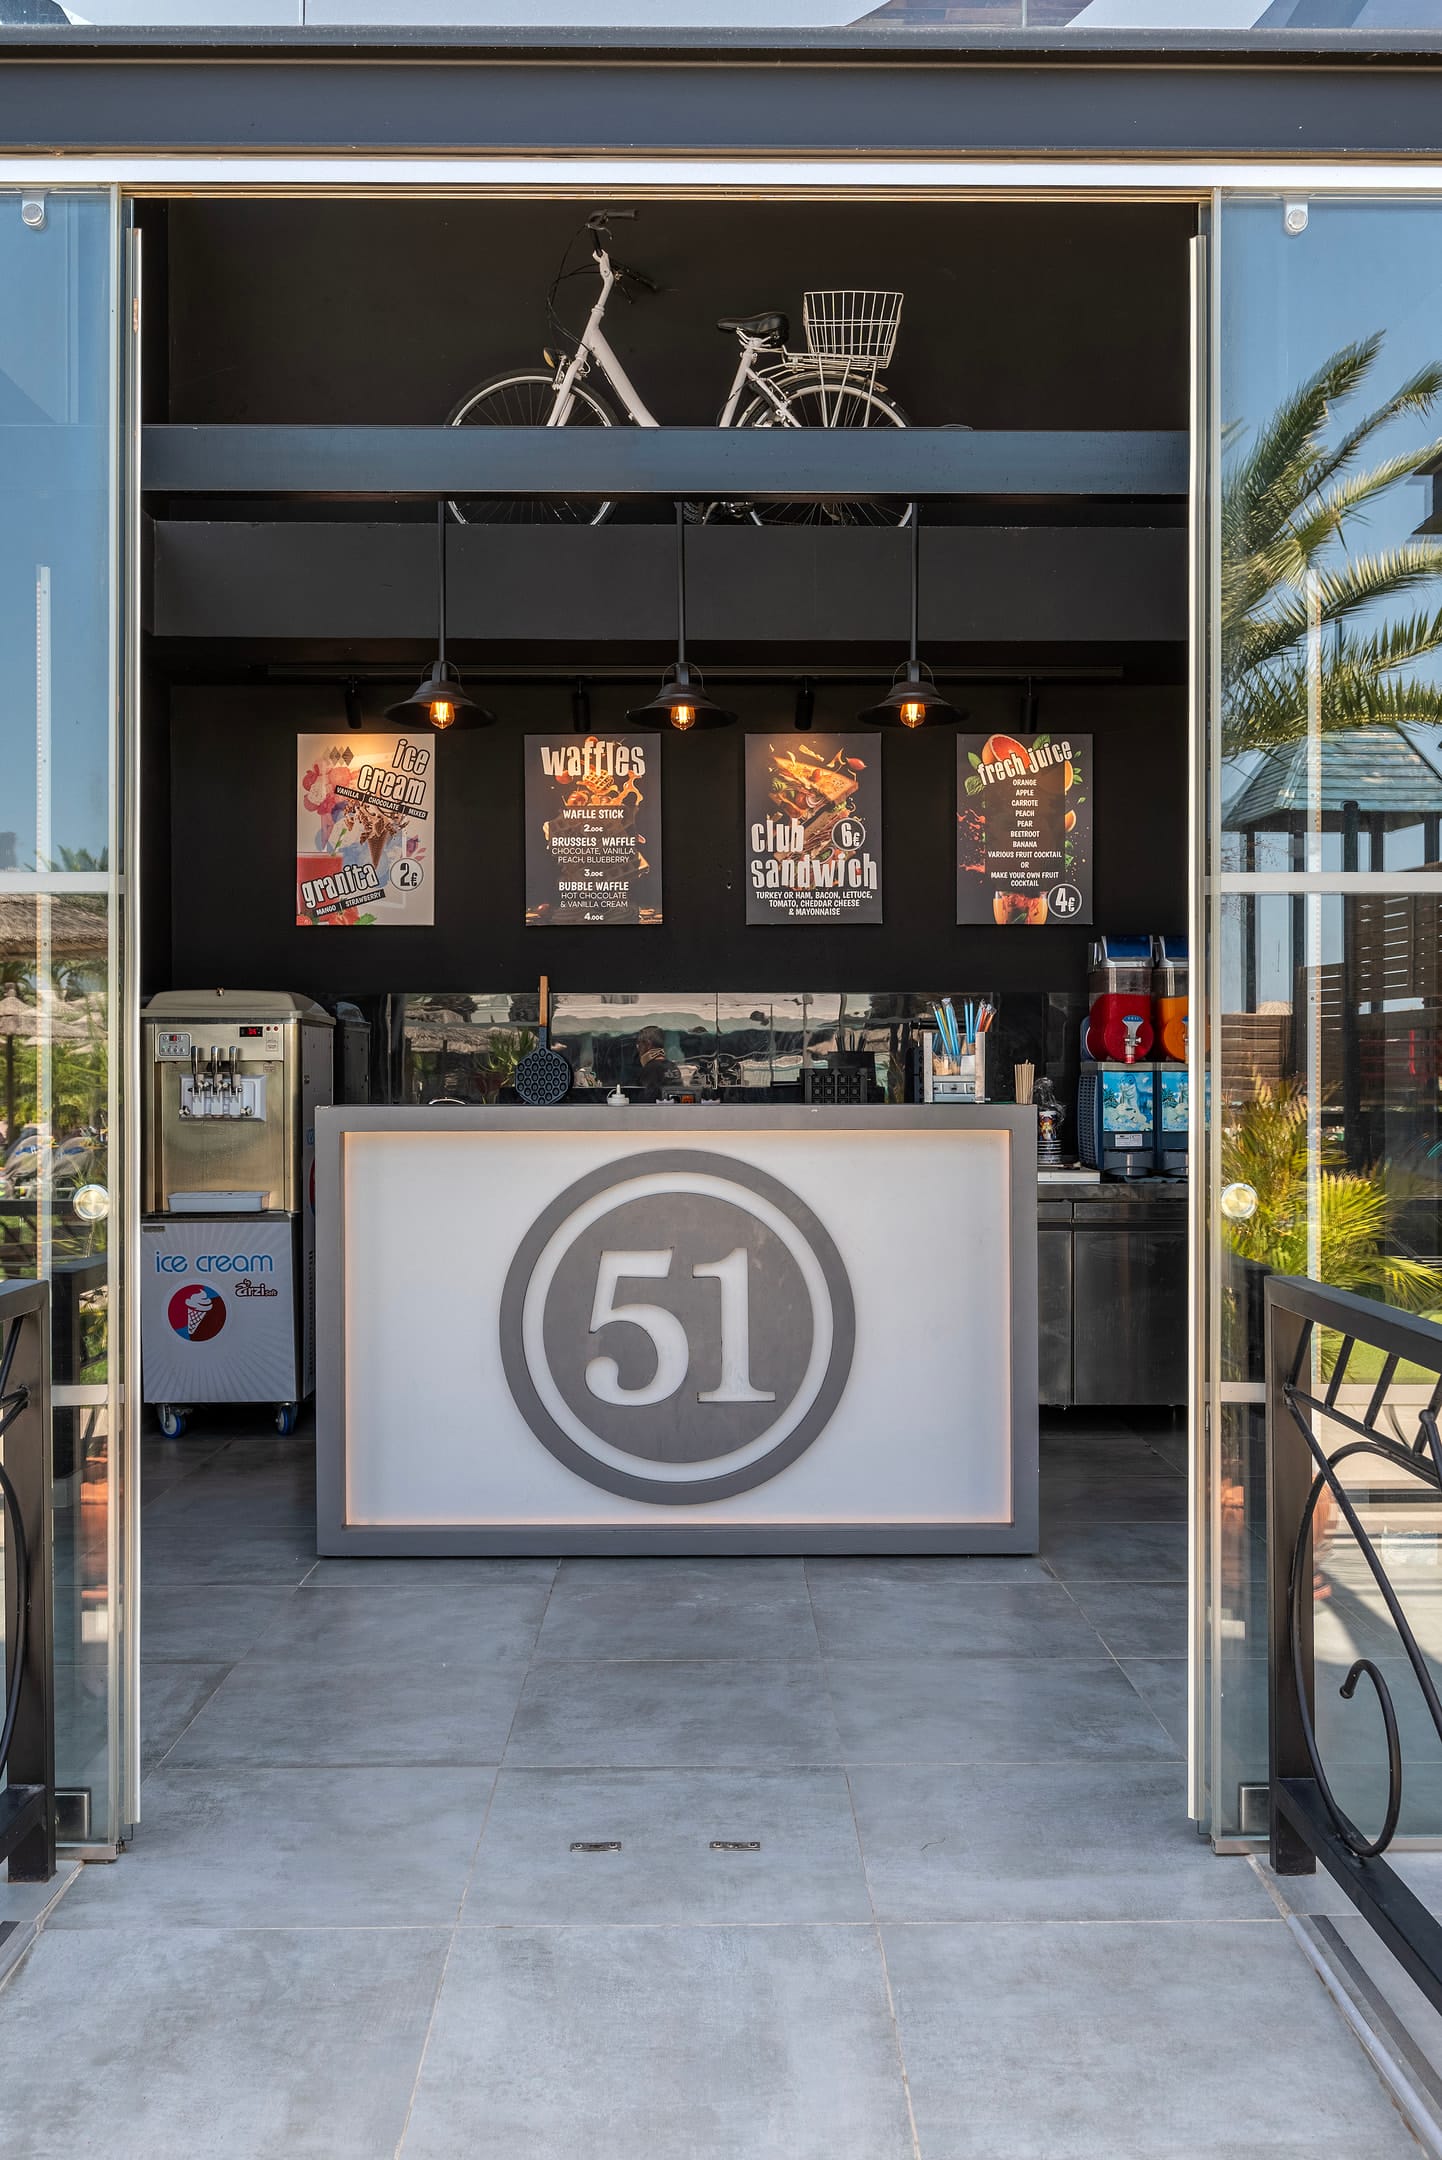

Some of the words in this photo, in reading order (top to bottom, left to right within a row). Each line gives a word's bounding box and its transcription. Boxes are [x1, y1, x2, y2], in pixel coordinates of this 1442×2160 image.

[392, 738, 430, 775] ice
[540, 741, 646, 777] waffles
[1027, 740, 1073, 774] juice
[357, 765, 427, 805] cream
[336, 786, 360, 799] VANILLA
[368, 796, 400, 811] CHOCOLATE
[408, 809, 427, 819] MIXED
[598, 809, 624, 819] STICK
[1011, 799, 1039, 807] CARROTE
[583, 824, 604, 833] 2.00€
[751, 818, 805, 853] club
[840, 822, 860, 847] 6€
[1010, 830, 1040, 838] BEETROOT
[551, 847, 601, 855] CHOCOLATE,
[602, 847, 636, 855] VANILLA,
[552, 837, 597, 847] BRUSSELS
[602, 837, 636, 846] WAFFLE
[399, 862, 418, 887] 2€
[751, 852, 878, 890] sandwich
[1020, 861, 1030, 869] OR
[301, 863, 380, 909] granita
[559, 881, 593, 891] BUBBLE
[595, 881, 629, 891] WAFFLE
[316, 904, 337, 916] MANGO
[345, 892, 382, 908] STRAWBERRY
[788, 908, 795, 916] &
[795, 908, 841, 916] MAYONNAISE
[834, 899, 860, 907] CHEESE
[1055, 887, 1075, 913] 4€
[156, 1251, 188, 1273] ice
[196, 1254, 273, 1273] cream
[584, 1246, 776, 1407] 51
